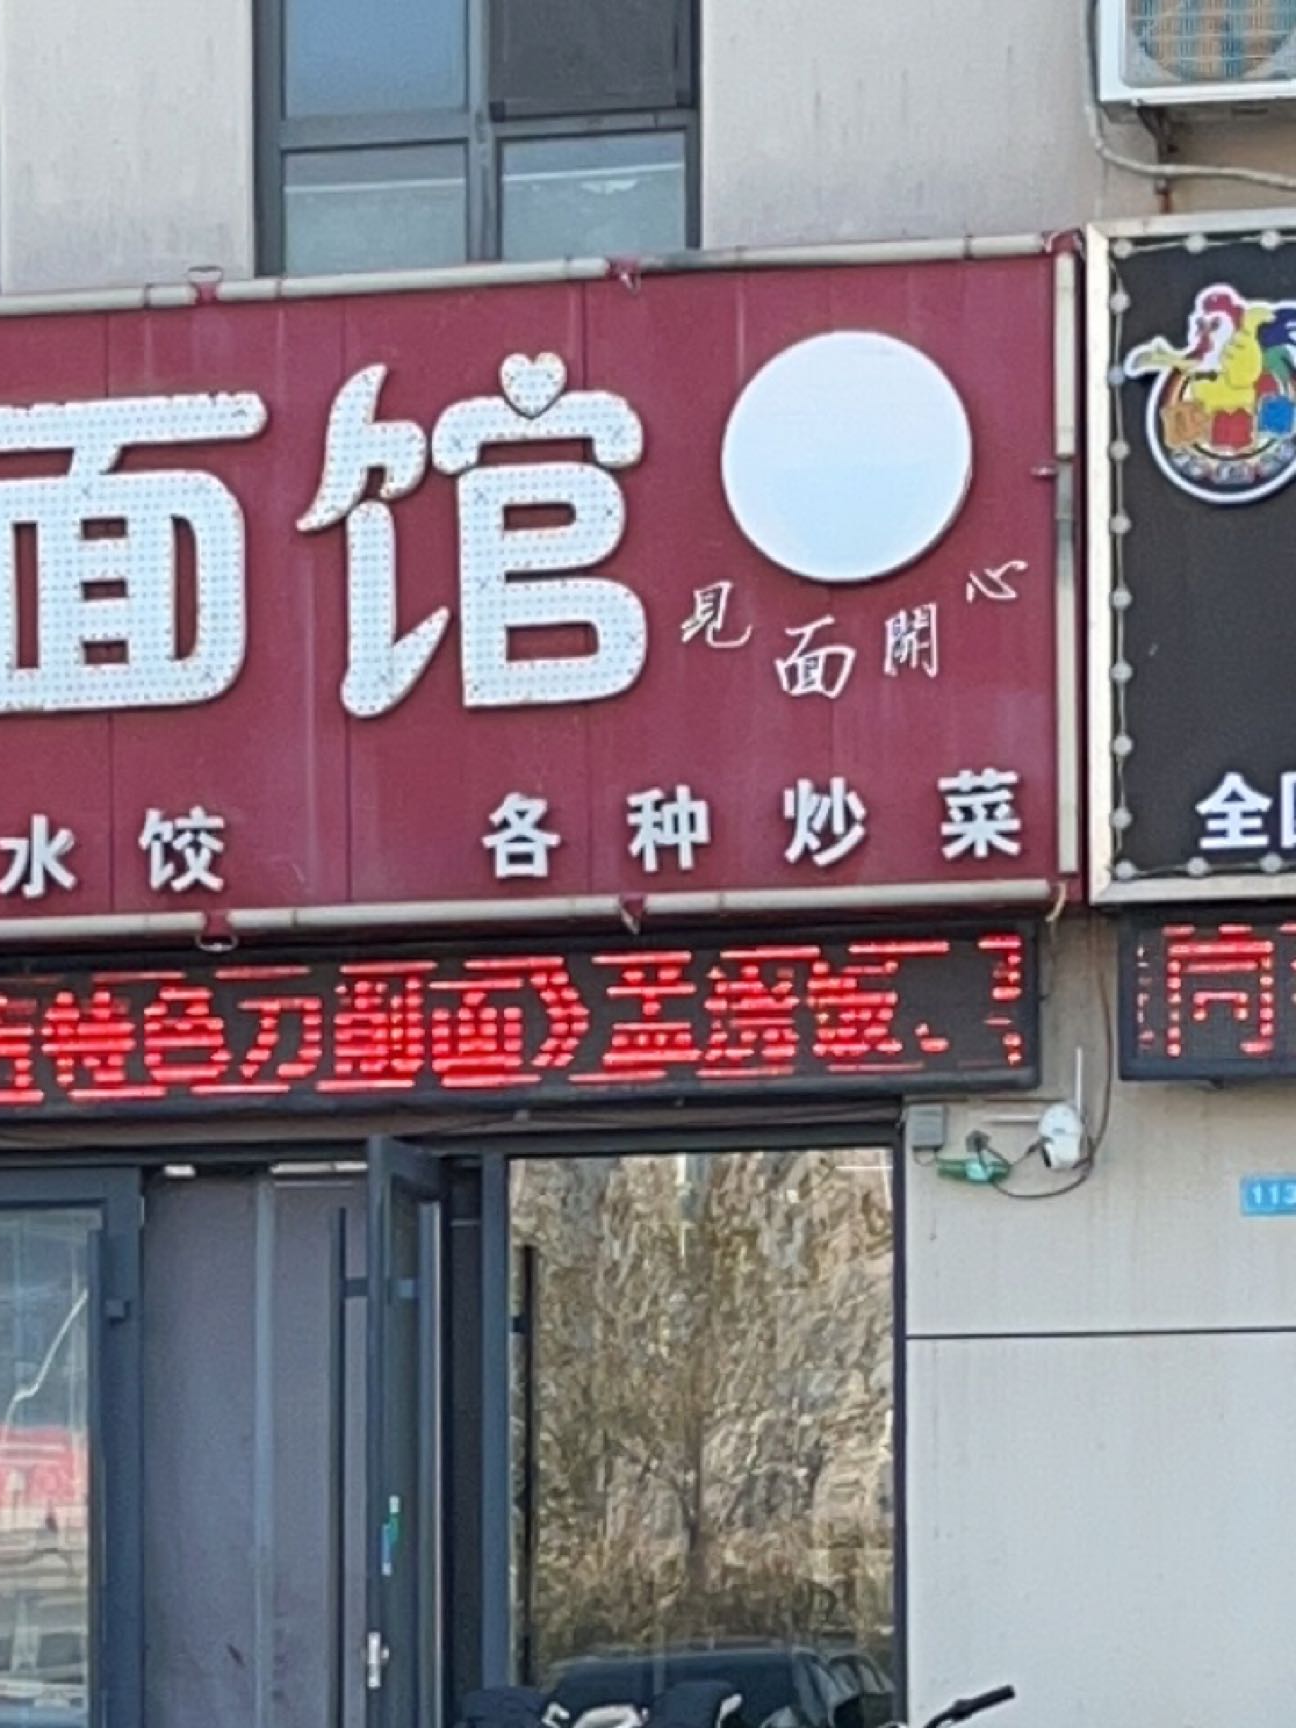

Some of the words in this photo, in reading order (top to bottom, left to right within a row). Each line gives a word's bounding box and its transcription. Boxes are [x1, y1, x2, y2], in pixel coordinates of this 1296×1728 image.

[481, 767, 1023, 882] 各种炒菜
[1195, 771, 1296, 850] 全
